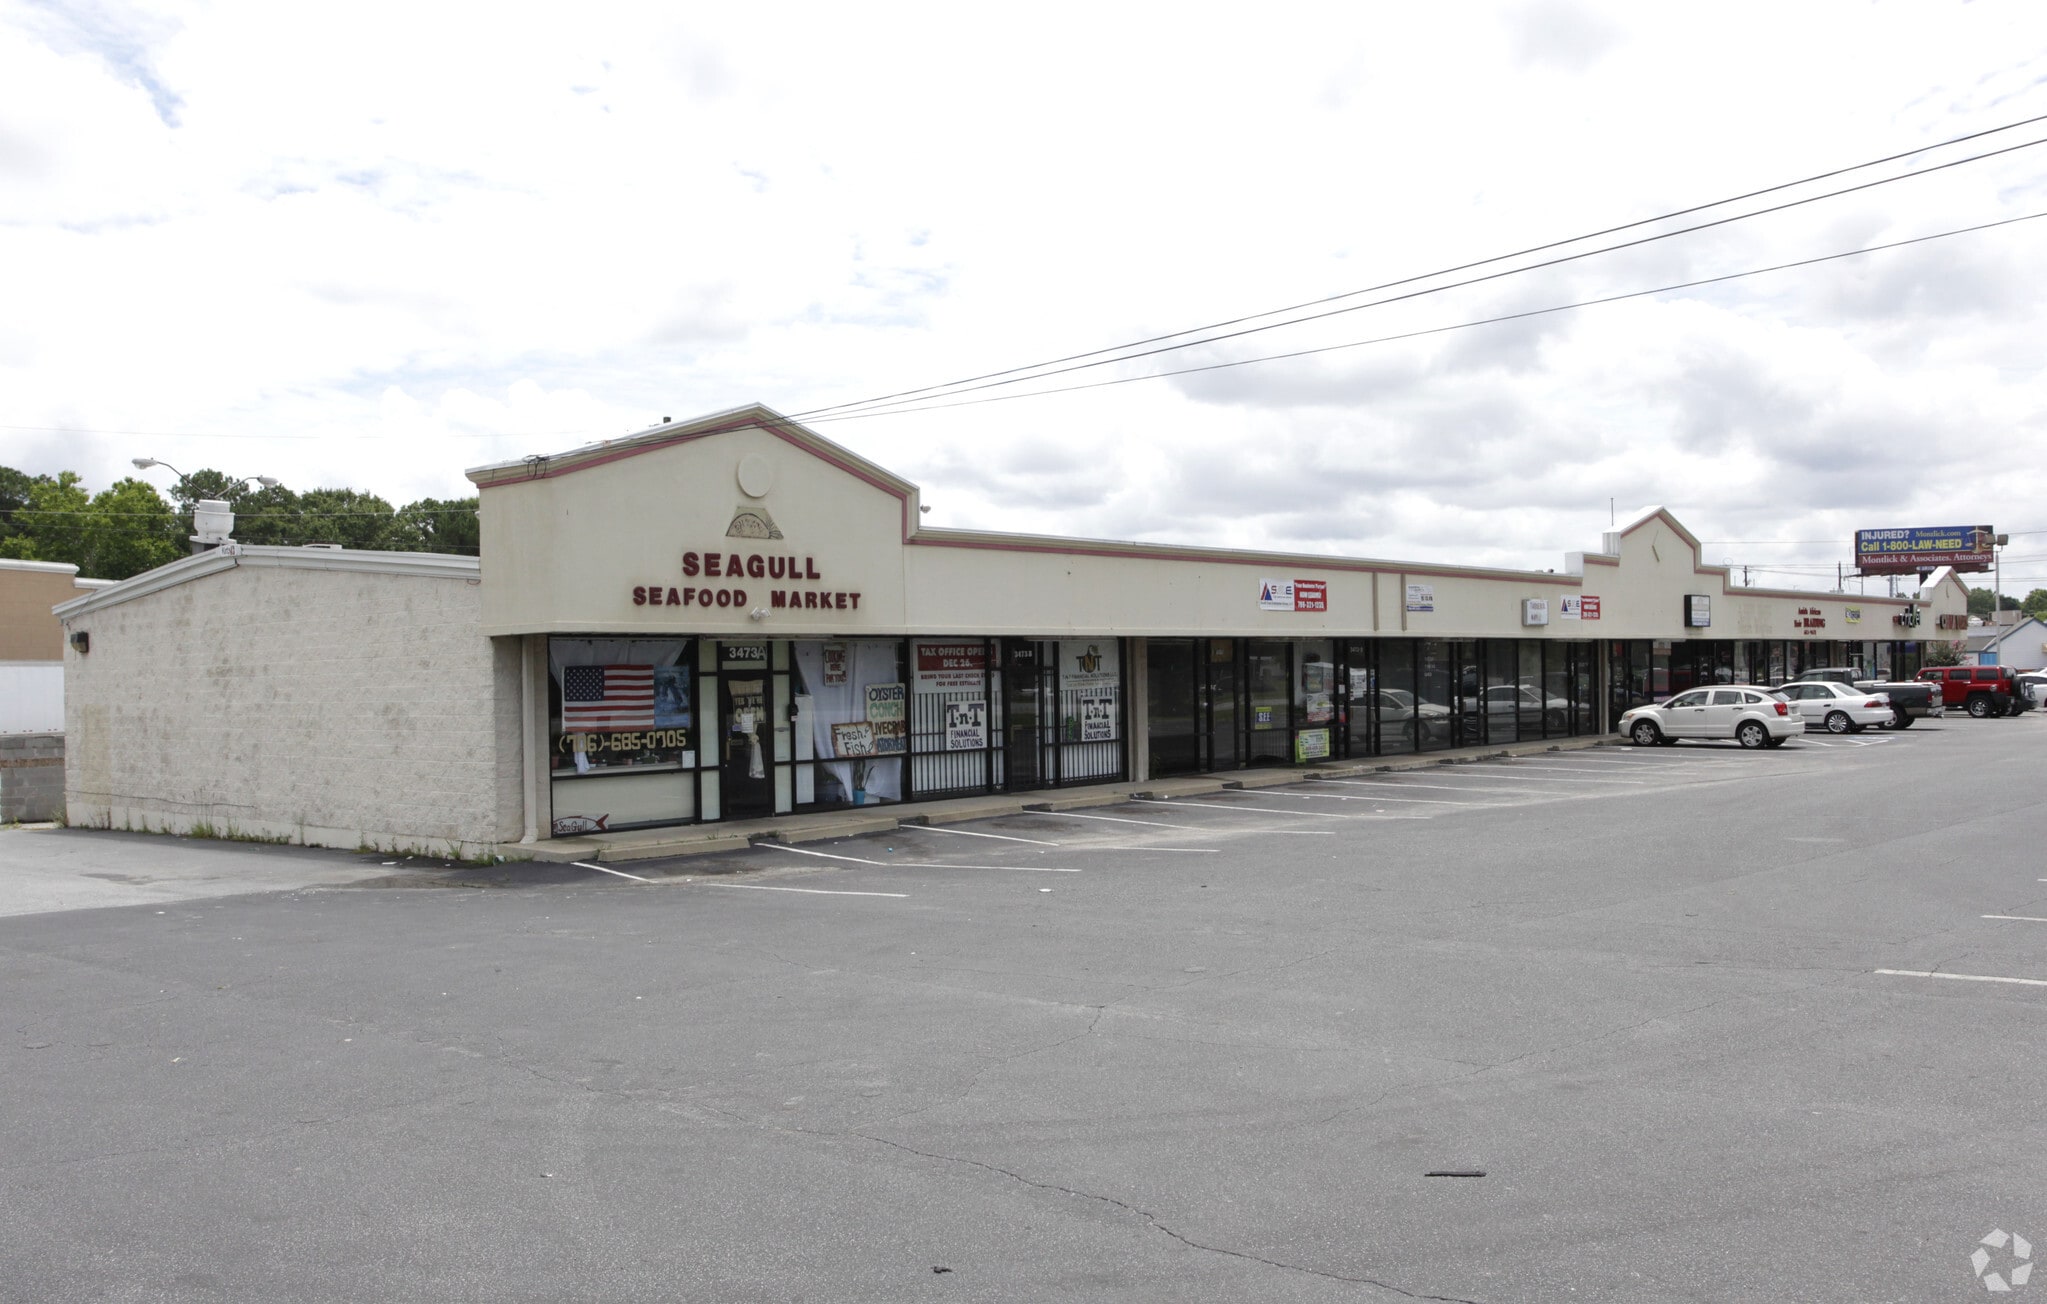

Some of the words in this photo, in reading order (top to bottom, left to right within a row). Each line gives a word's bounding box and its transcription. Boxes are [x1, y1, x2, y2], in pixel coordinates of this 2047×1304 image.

[1861, 530, 1910, 540] INJURED?
[1861, 541, 1879, 552] Call
[1882, 539, 1962, 551] 1-800-LAW-NEED
[1862, 554, 1898, 564] Montlick
[1953, 553, 1992, 563] Attorneys
[682, 551, 821, 580] SEAGULL
[632, 586, 748, 607] SEAFOOD
[771, 590, 861, 609] MARKET
[729, 646, 767, 660] 3473A
[921, 647, 936, 657] TAX
[941, 647, 964, 656] OFFICE
[943, 659, 959, 667] DEC
[869, 685, 904, 701] OYSTER
[869, 701, 903, 718] CONCH
[950, 729, 980, 738] FINANCIAL
[1084, 730, 1111, 740] SOLUTIONS
[950, 738, 983, 749] SOLUTIONS
